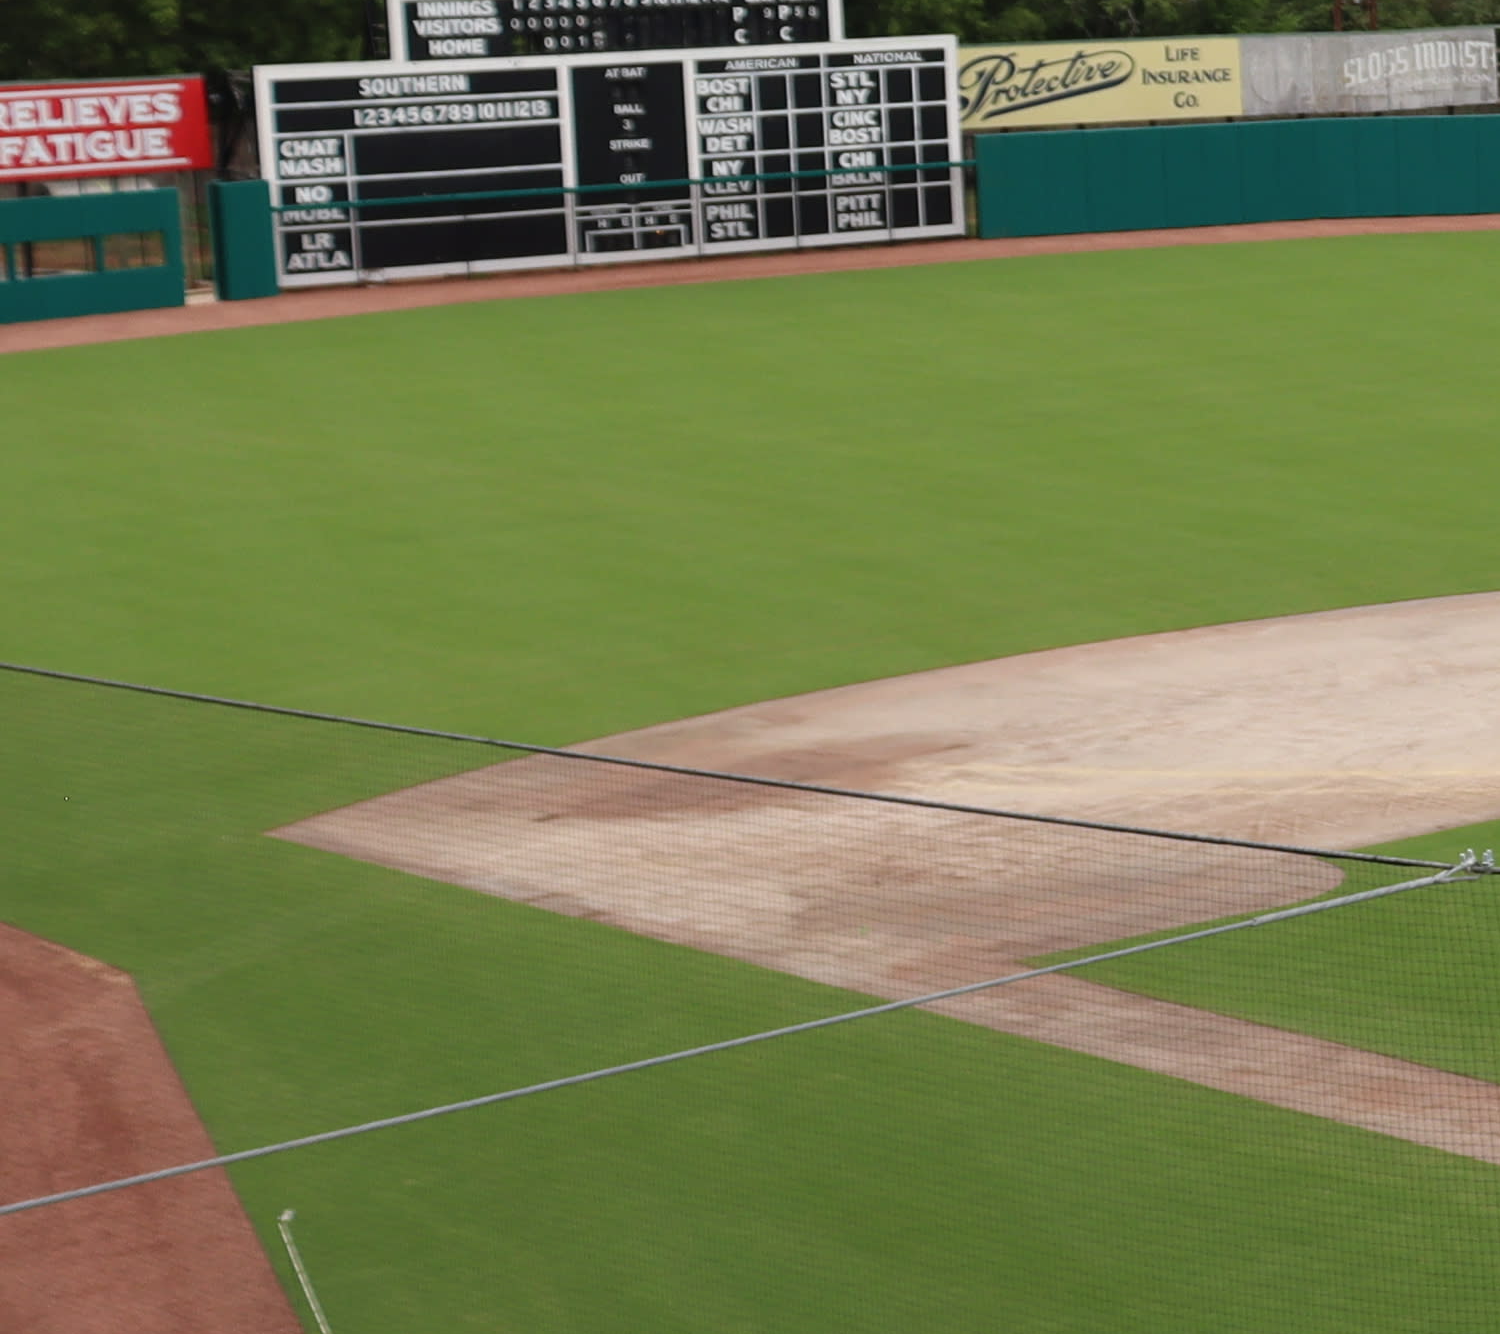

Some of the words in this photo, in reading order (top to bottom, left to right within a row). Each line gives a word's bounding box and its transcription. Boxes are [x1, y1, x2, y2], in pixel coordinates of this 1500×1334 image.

[416, 0, 498, 18] INNINGS
[413, 17, 503, 37] VISITORS
[510, 18, 523, 30] 0
[527, 18, 540, 29] 0
[544, 17, 556, 28] 0
[559, 17, 573, 28] 0
[576, 15, 589, 27] 0
[732, 7, 747, 22] P
[778, 5, 792, 20] P
[428, 38, 488, 56] HOME
[543, 37, 557, 48] 0
[559, 36, 573, 47] 0
[734, 28, 749, 44] C
[779, 26, 793, 41] C
[725, 58, 799, 71] AMERICAN
[853, 50, 924, 64] NATIONAL
[605, 69, 619, 78] AT
[621, 67, 645, 77] BAT
[1343, 46, 1410, 88] SLOSS
[358, 74, 467, 97] SOUTHERN
[696, 78, 750, 95] BOST
[830, 71, 877, 88] STL
[706, 96, 743, 112] CHI
[836, 88, 871, 105] NY
[614, 104, 645, 115] BALL
[832, 110, 878, 127] CINC
[622, 119, 634, 130] 3
[698, 117, 753, 135] WASH
[609, 138, 651, 151] STRIKE
[706, 135, 750, 152] DET
[829, 127, 881, 145] BOST
[0, 128, 172, 166] FATIGUE
[280, 138, 341, 157] CHAT
[279, 157, 345, 176] NASH
[711, 160, 744, 176] NY
[838, 151, 877, 168] CHI
[620, 173, 645, 184] OUT
[295, 185, 333, 203] NO
[836, 193, 882, 212] PITT
[706, 203, 755, 221] PHIL
[837, 210, 885, 229] PHIL
[710, 221, 753, 239] STL
[301, 232, 335, 250] LR
[288, 251, 352, 270] ATLA
